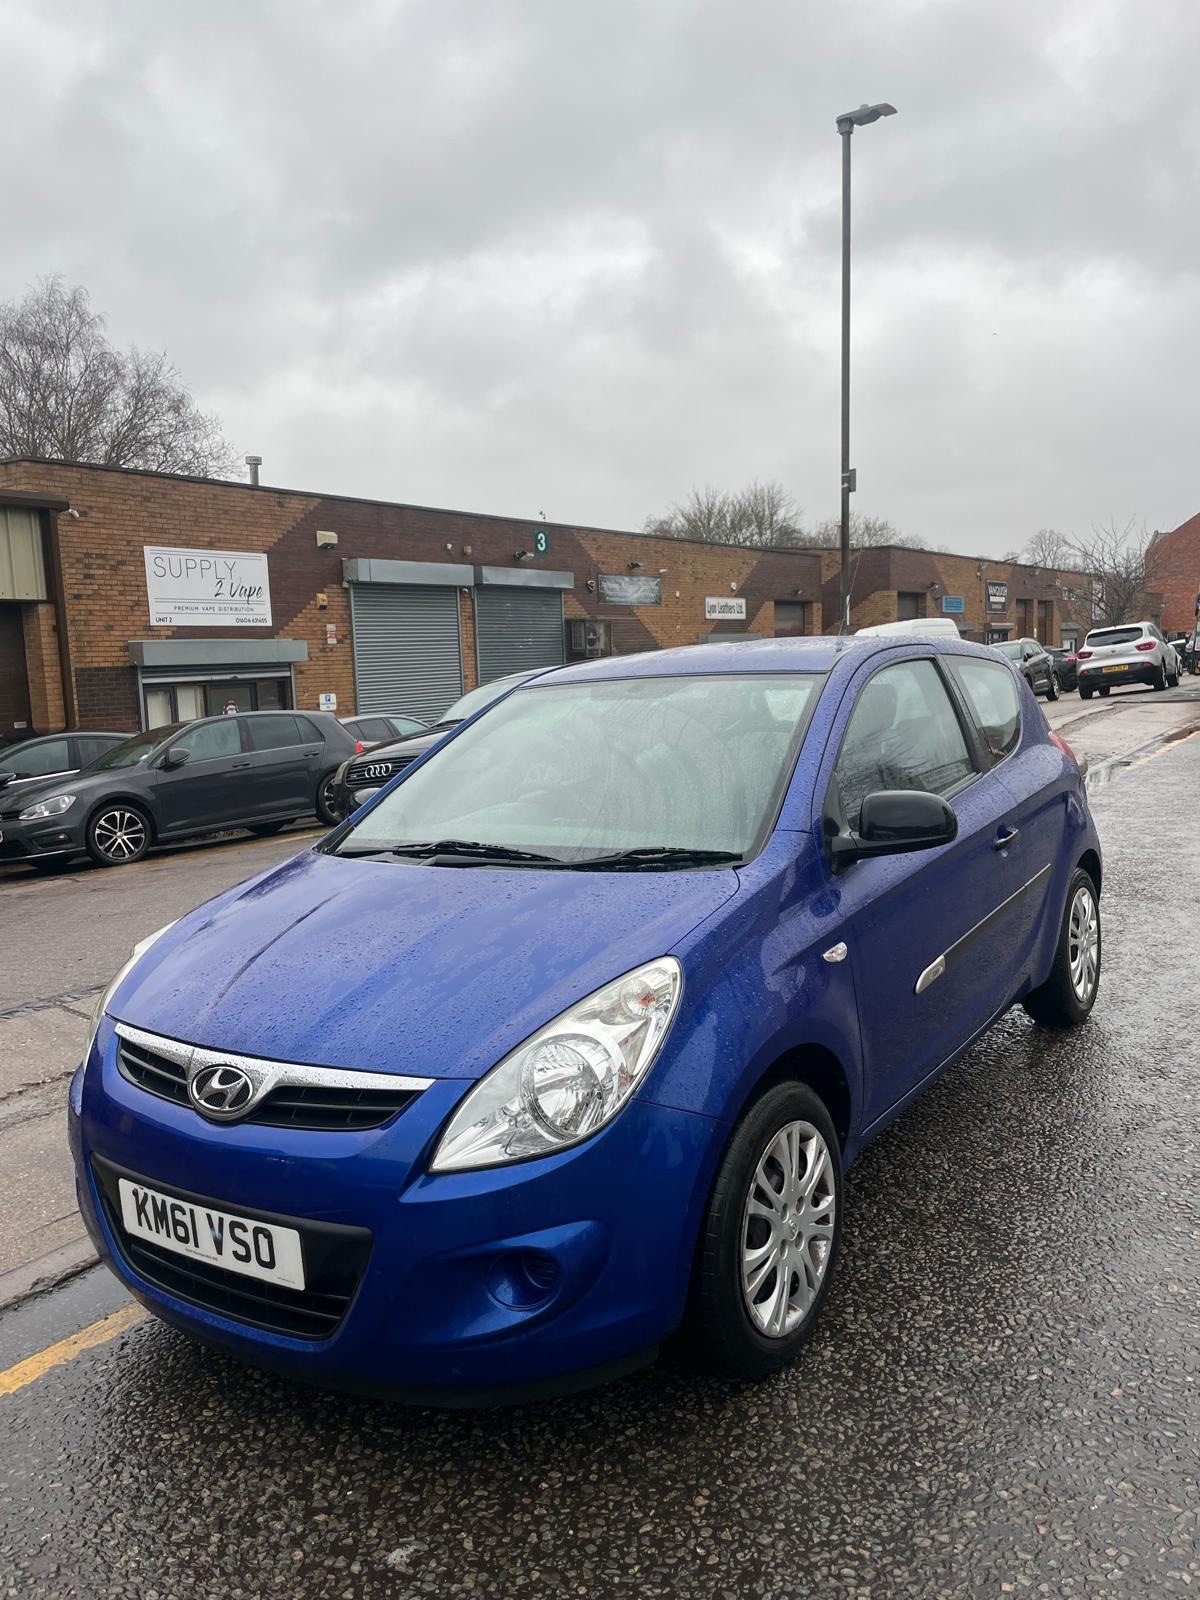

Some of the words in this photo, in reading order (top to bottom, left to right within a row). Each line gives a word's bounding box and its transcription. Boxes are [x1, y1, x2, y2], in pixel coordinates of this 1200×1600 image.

[537, 532, 546, 551] 3
[153, 556, 236, 580] SUPPLY
[214, 580, 225, 598] 2
[229, 576, 264, 605] Vape
[717, 601, 736, 614] Leathers
[132, 1187, 200, 1249] KM61
